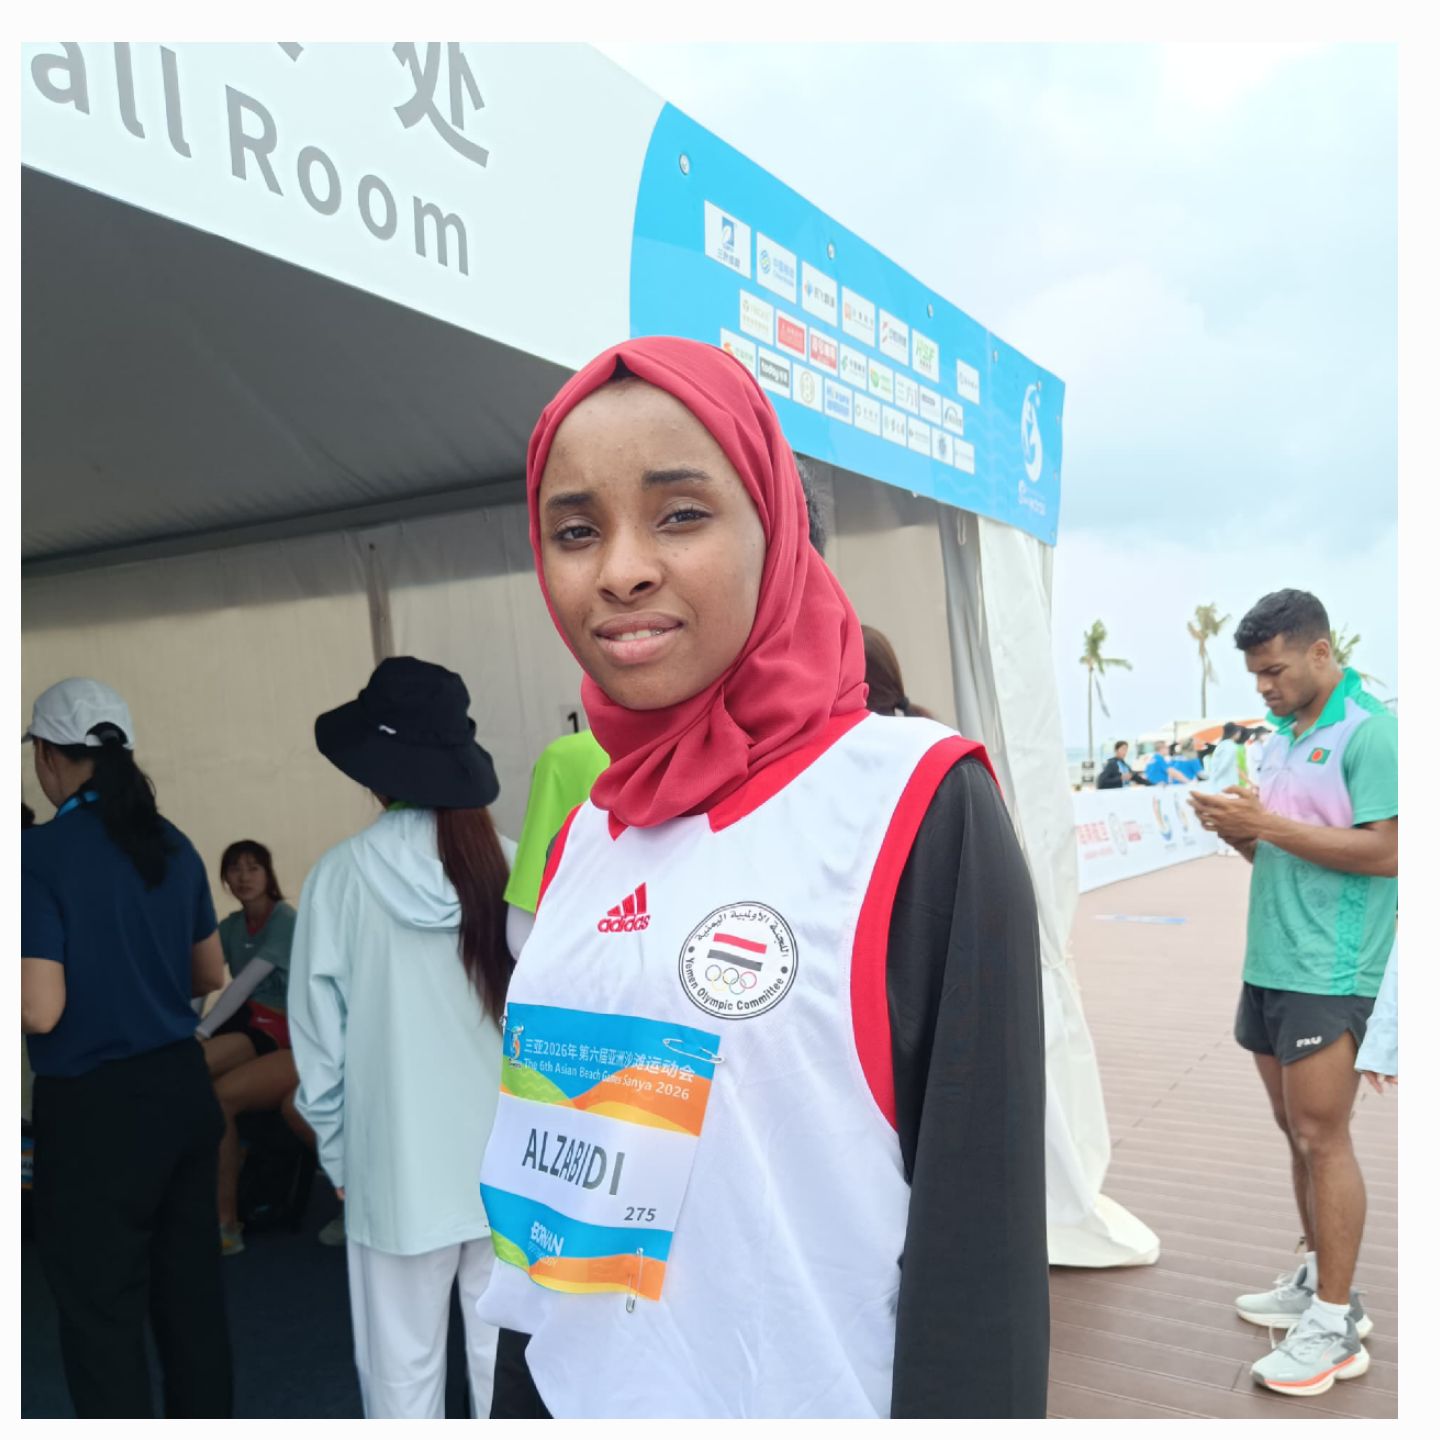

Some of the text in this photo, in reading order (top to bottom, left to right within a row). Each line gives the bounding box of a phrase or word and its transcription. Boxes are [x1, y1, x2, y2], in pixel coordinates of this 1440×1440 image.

[225, 84, 470, 277] Room
[598, 913, 651, 933] adidas
[685, 957, 785, 1011] Yemen Olympic Committee
[539, 1060, 553, 1072] 6th
[555, 1062, 578, 1077] Asian
[579, 1066, 601, 1081] Beach
[623, 1075, 653, 1092] Sanya
[655, 1081, 690, 1100] 2026
[522, 1128, 625, 1196] ALZABIDI
[624, 1207, 657, 1222] 275
